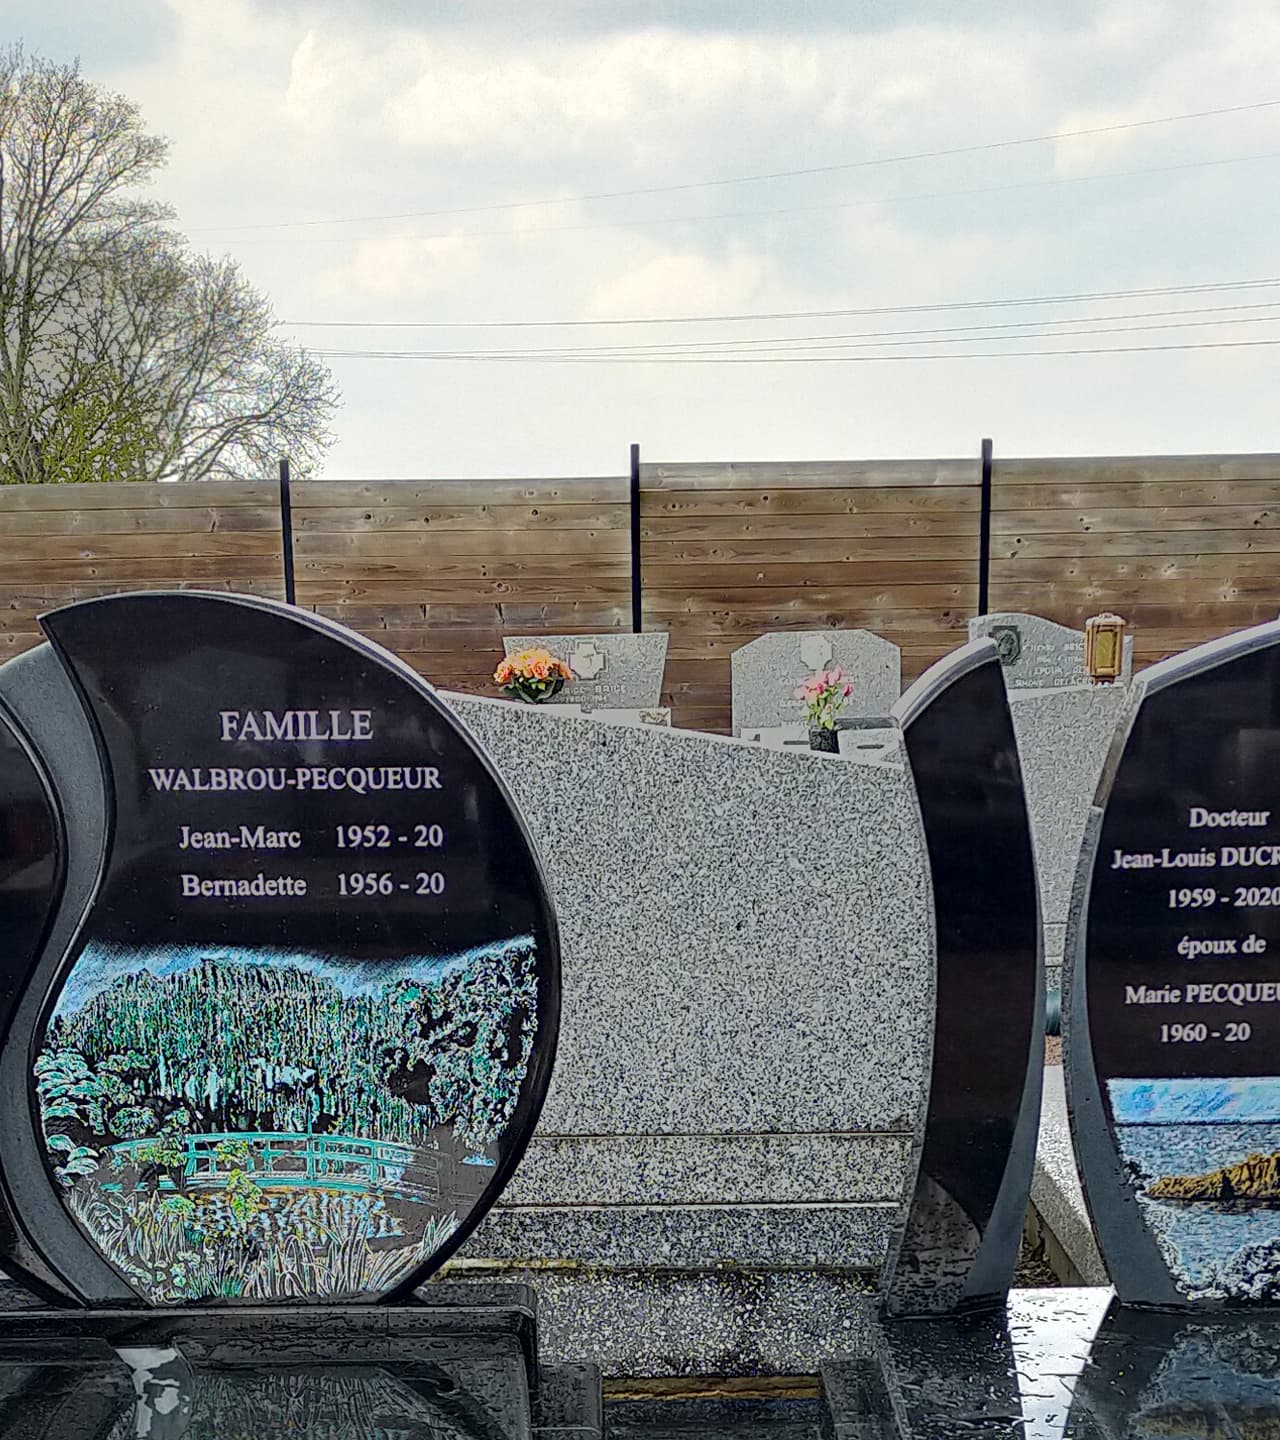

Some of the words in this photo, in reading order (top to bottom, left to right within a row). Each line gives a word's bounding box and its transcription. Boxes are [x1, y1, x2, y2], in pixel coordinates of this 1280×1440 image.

[219, 710, 374, 741] FAMILLE
[148, 767, 443, 794] WALBROU-PECQUEUR
[1189, 807, 1270, 828] Docteur
[179, 826, 301, 849] Jean-Marc
[336, 825, 391, 848] 1952
[414, 824, 443, 847] 20
[1111, 847, 1216, 870] Jean-Louis
[181, 873, 307, 897] Bernadette
[338, 873, 393, 895] 1956
[416, 872, 445, 894] 20
[1169, 888, 1216, 908] 1959
[1177, 935, 1237, 959] époux
[1241, 934, 1267, 954] de
[1125, 984, 1181, 1004] Marie
[1161, 1023, 1207, 1042] 1960
[1224, 1022, 1251, 1042] 20
